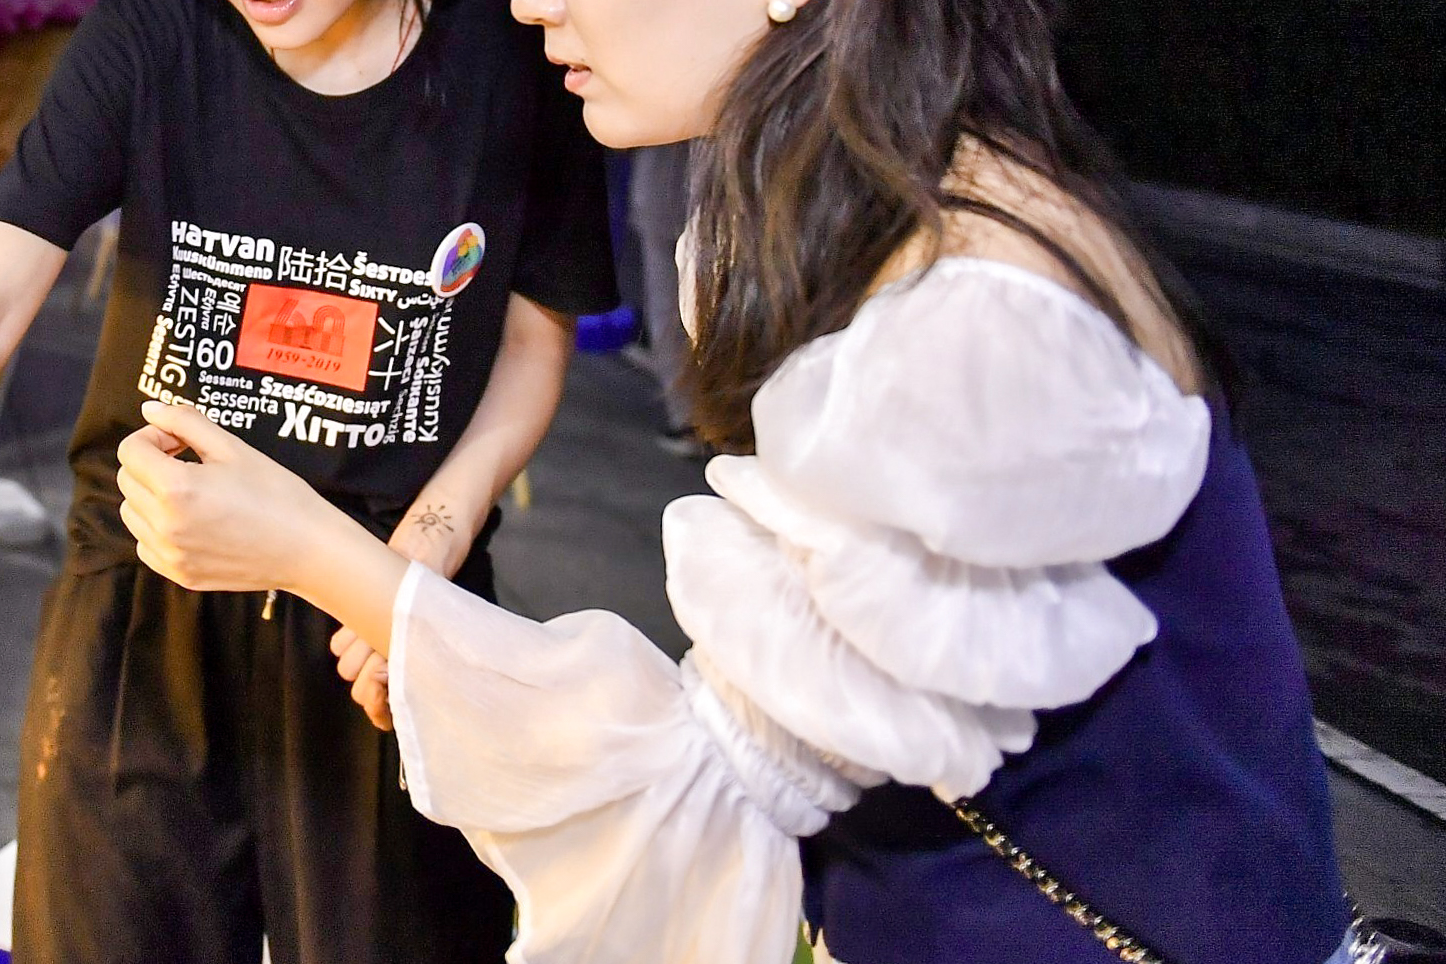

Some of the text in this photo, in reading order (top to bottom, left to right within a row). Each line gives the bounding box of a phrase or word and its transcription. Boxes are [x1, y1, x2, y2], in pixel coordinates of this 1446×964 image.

[277, 246, 351, 291] 陆拾
[196, 337, 235, 371] 60
[266, 347, 342, 373] 1959-2019
[198, 370, 254, 390] Sessanta
[197, 385, 279, 415] Sessenta
